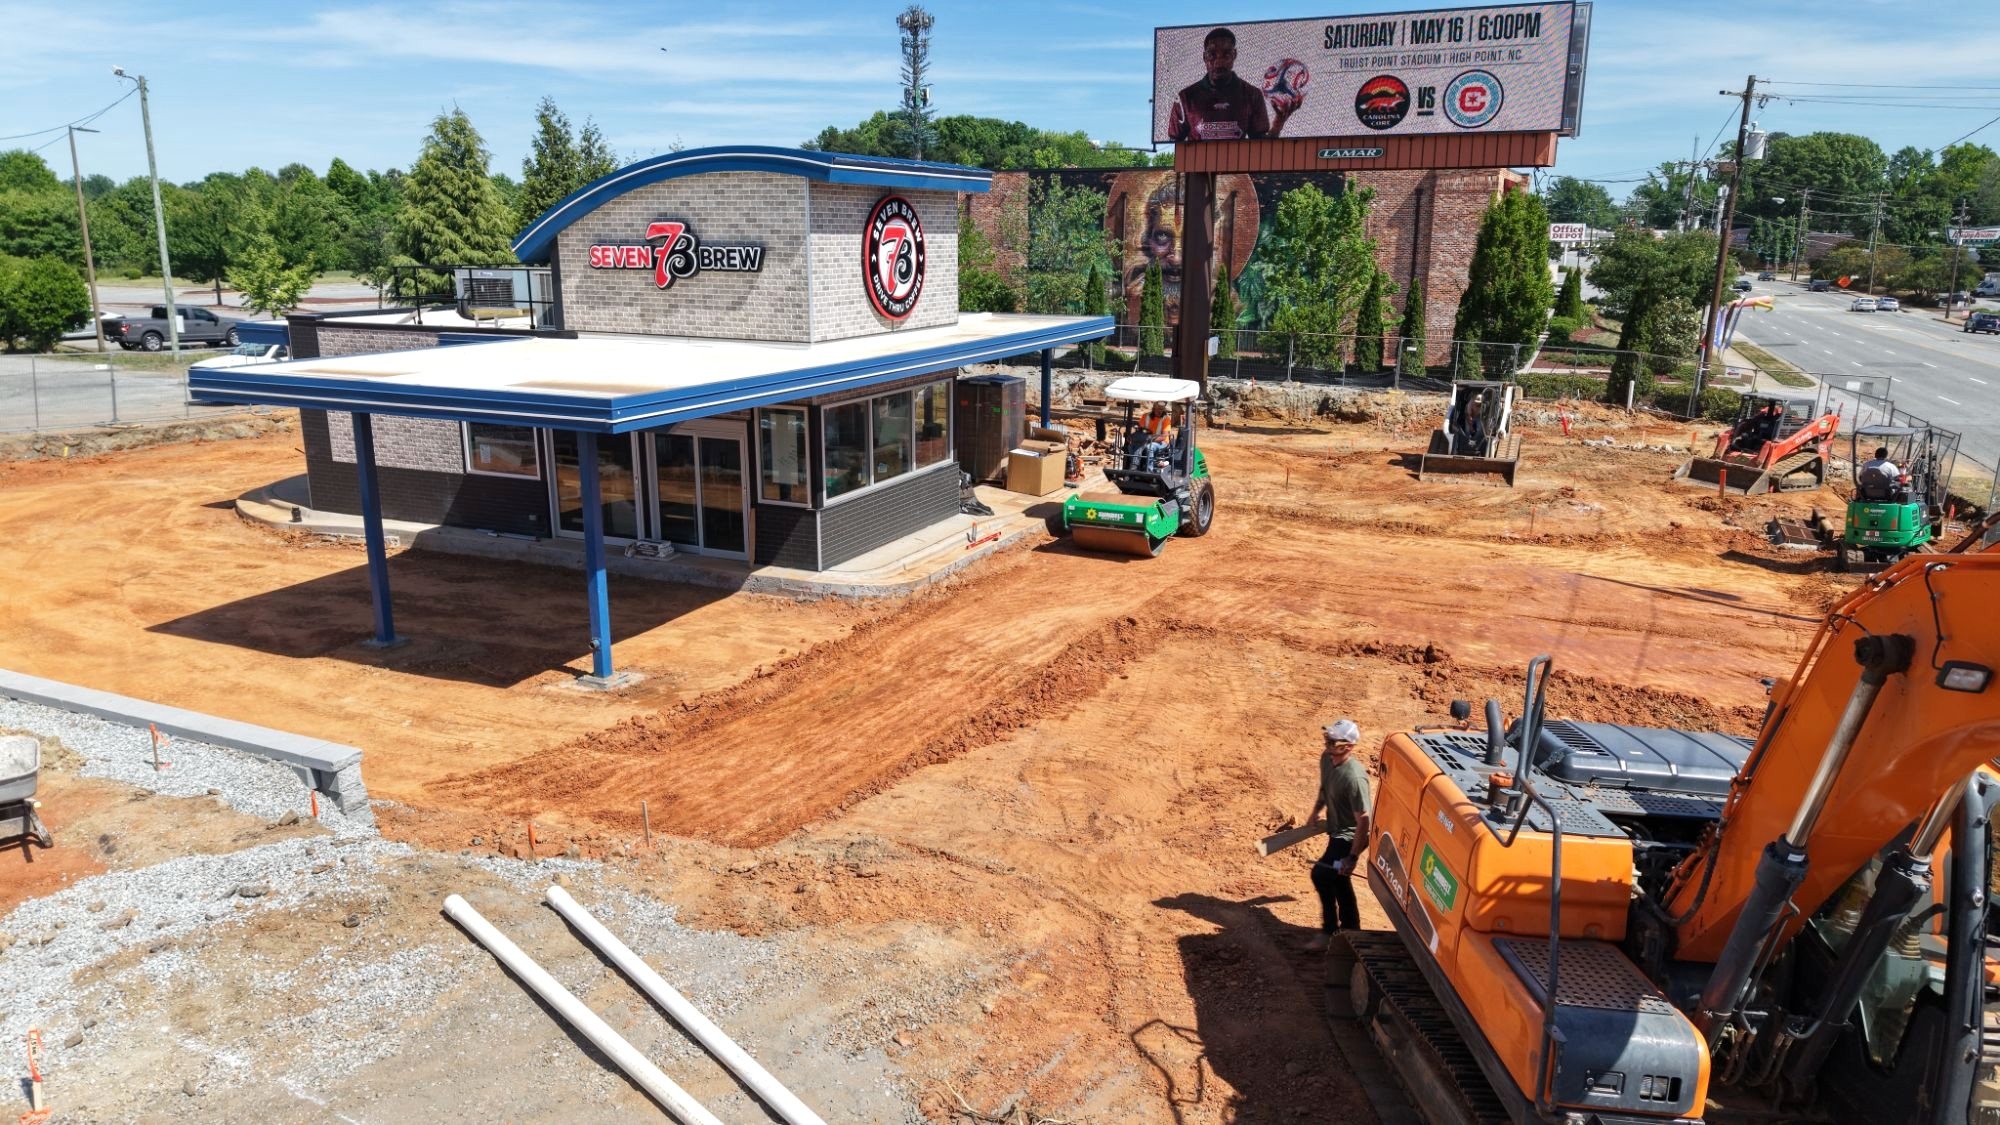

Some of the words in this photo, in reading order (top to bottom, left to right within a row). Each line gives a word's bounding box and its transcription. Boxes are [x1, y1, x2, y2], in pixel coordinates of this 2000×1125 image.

[1324, 21, 1397, 50] SATURDAY
[1410, 18, 1445, 45] MAY
[1447, 16, 1464, 43] 16
[1478, 12, 1542, 41] 6:00PM
[1339, 57, 1369, 69] TRUIST
[1371, 55, 1398, 67] POINT
[1400, 53, 1441, 66] STADIUM
[1449, 51, 1472, 63] HIGH
[1508, 49, 1522, 60] NC
[1417, 86, 1436, 109] VS
[1323, 149, 1377, 157] LAMAR
[873, 201, 899, 241] SEVEN
[901, 203, 922, 242] BREW
[589, 245, 652, 269] SEVEN
[699, 246, 761, 271] BREW
[873, 273, 888, 306] DRIVE
[888, 300, 905, 312] THRU
[905, 273, 923, 309] COFFEE
